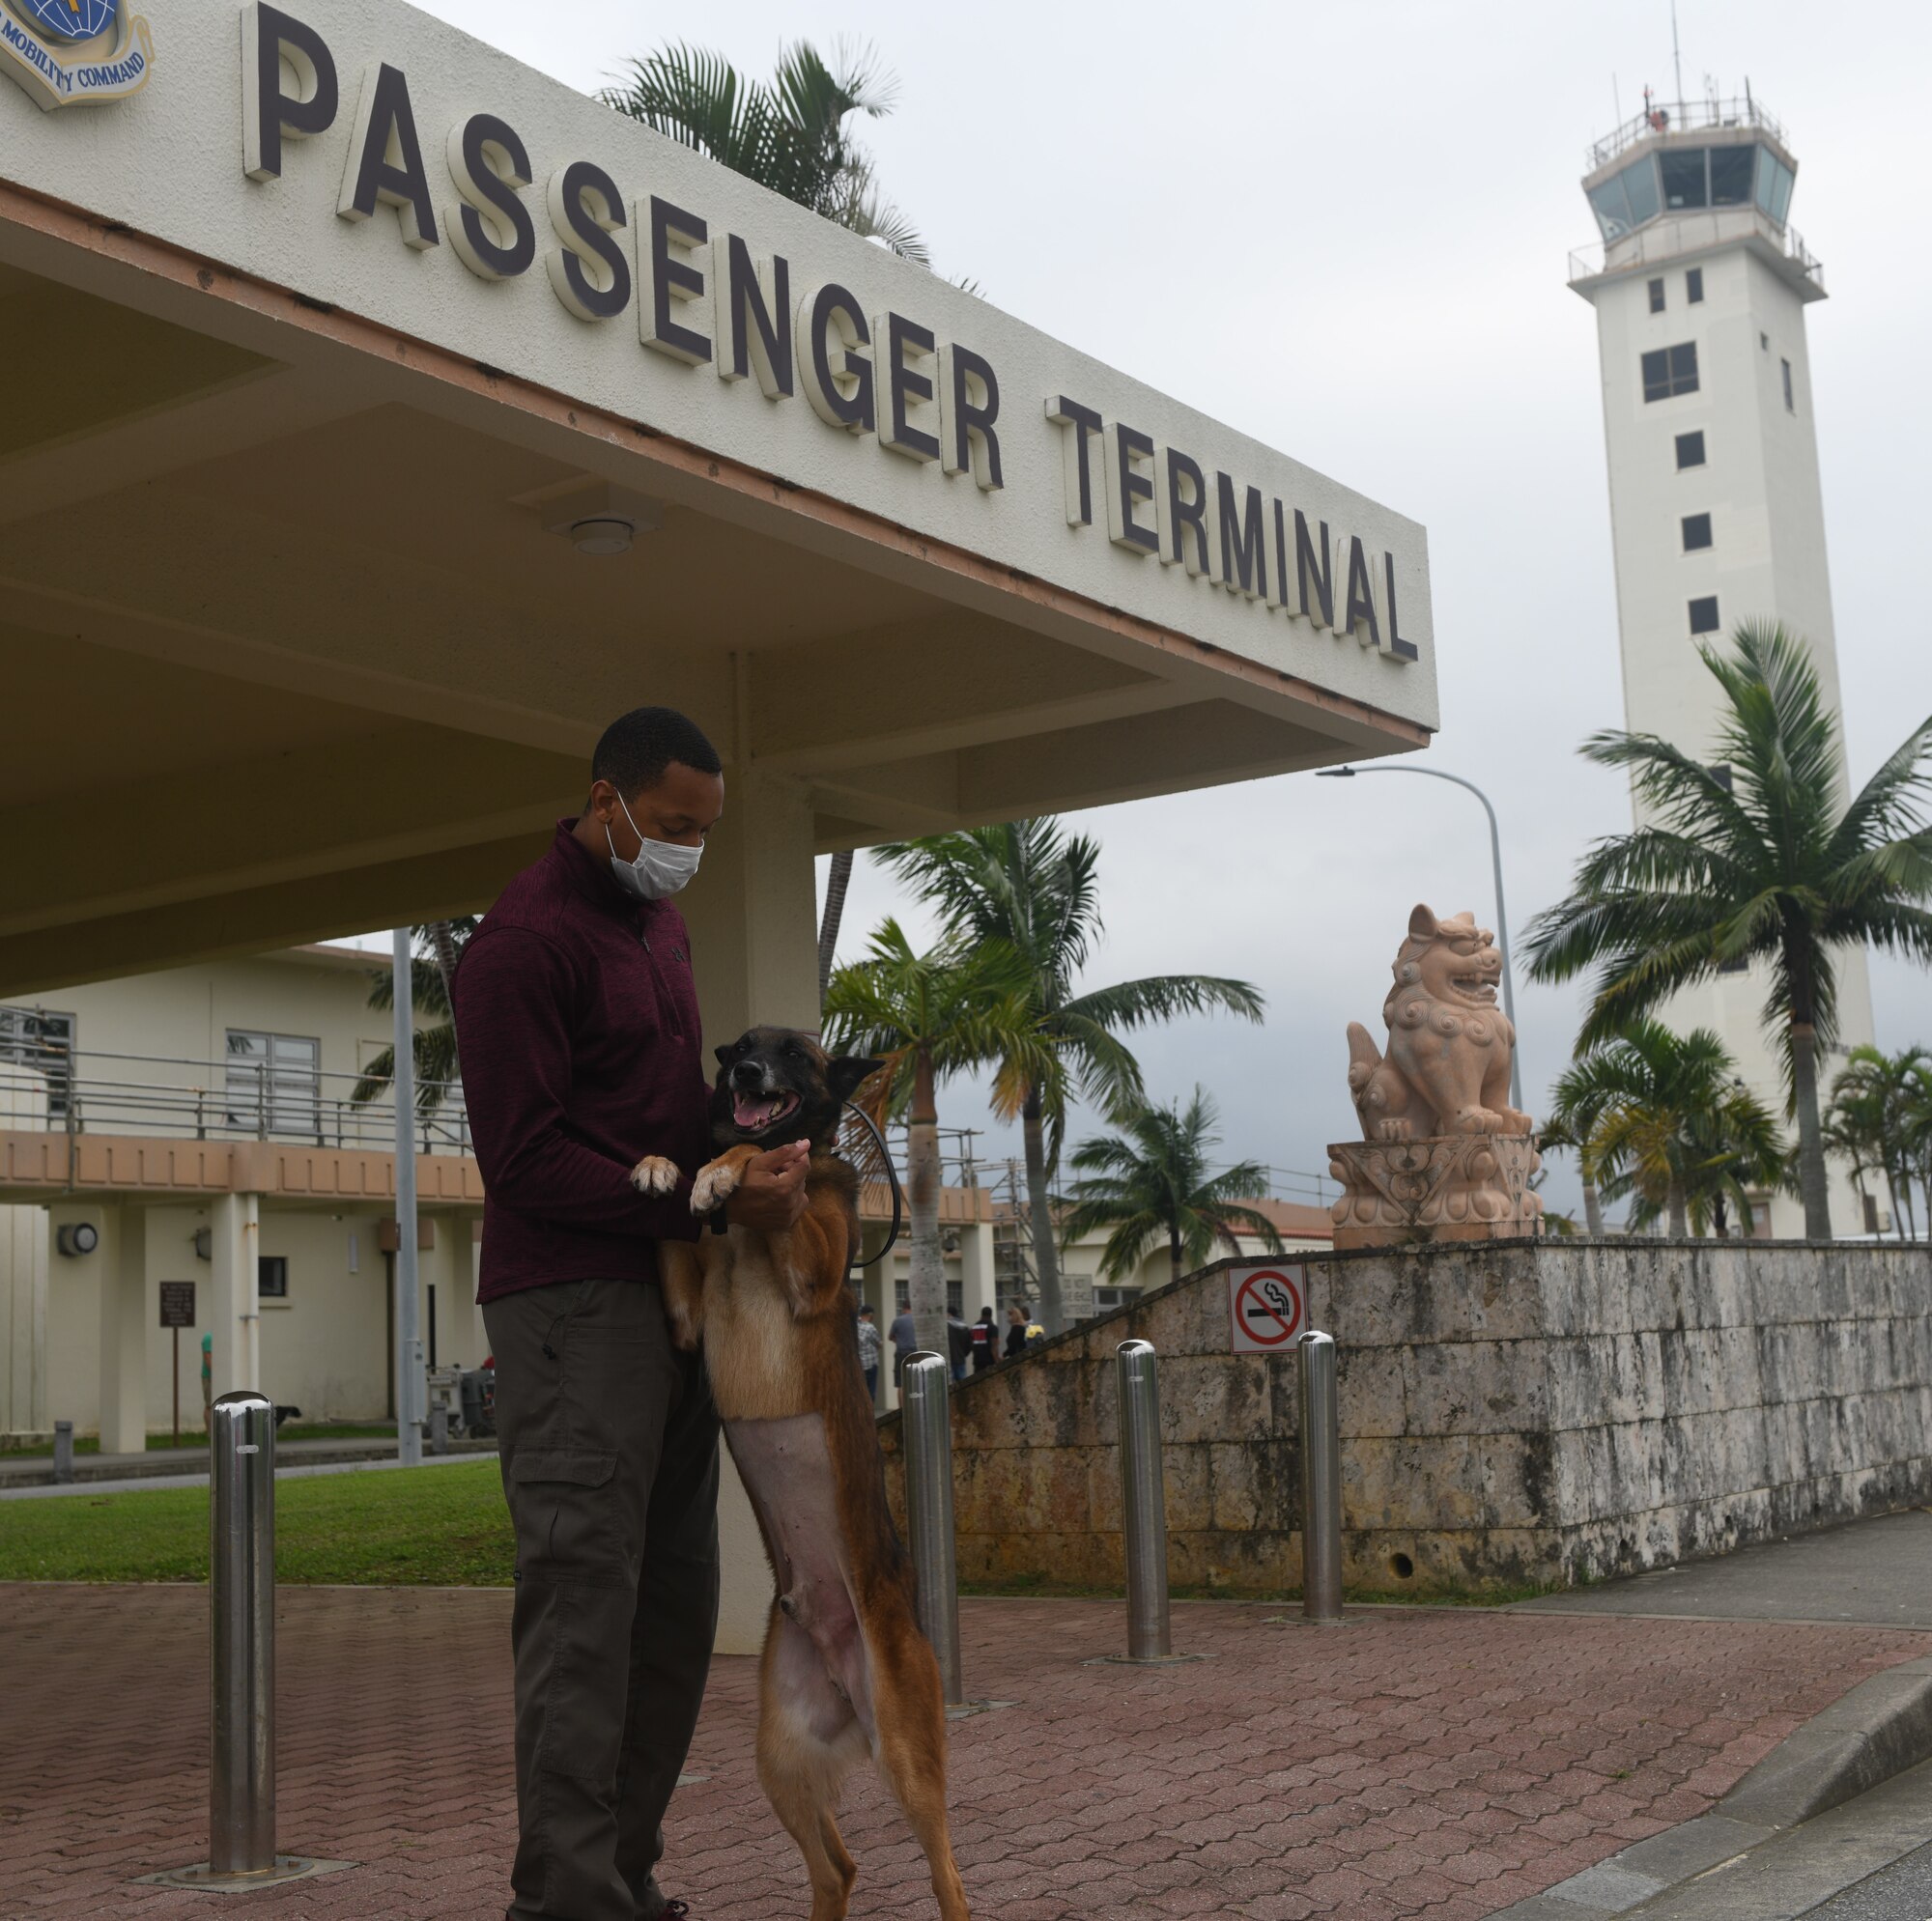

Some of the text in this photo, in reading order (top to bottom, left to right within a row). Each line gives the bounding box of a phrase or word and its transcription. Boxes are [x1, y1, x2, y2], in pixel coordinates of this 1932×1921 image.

[1, 19, 145, 92] MOBILITY COMMAND
[243, 1, 1418, 664] PASSENGER TERMINAL
